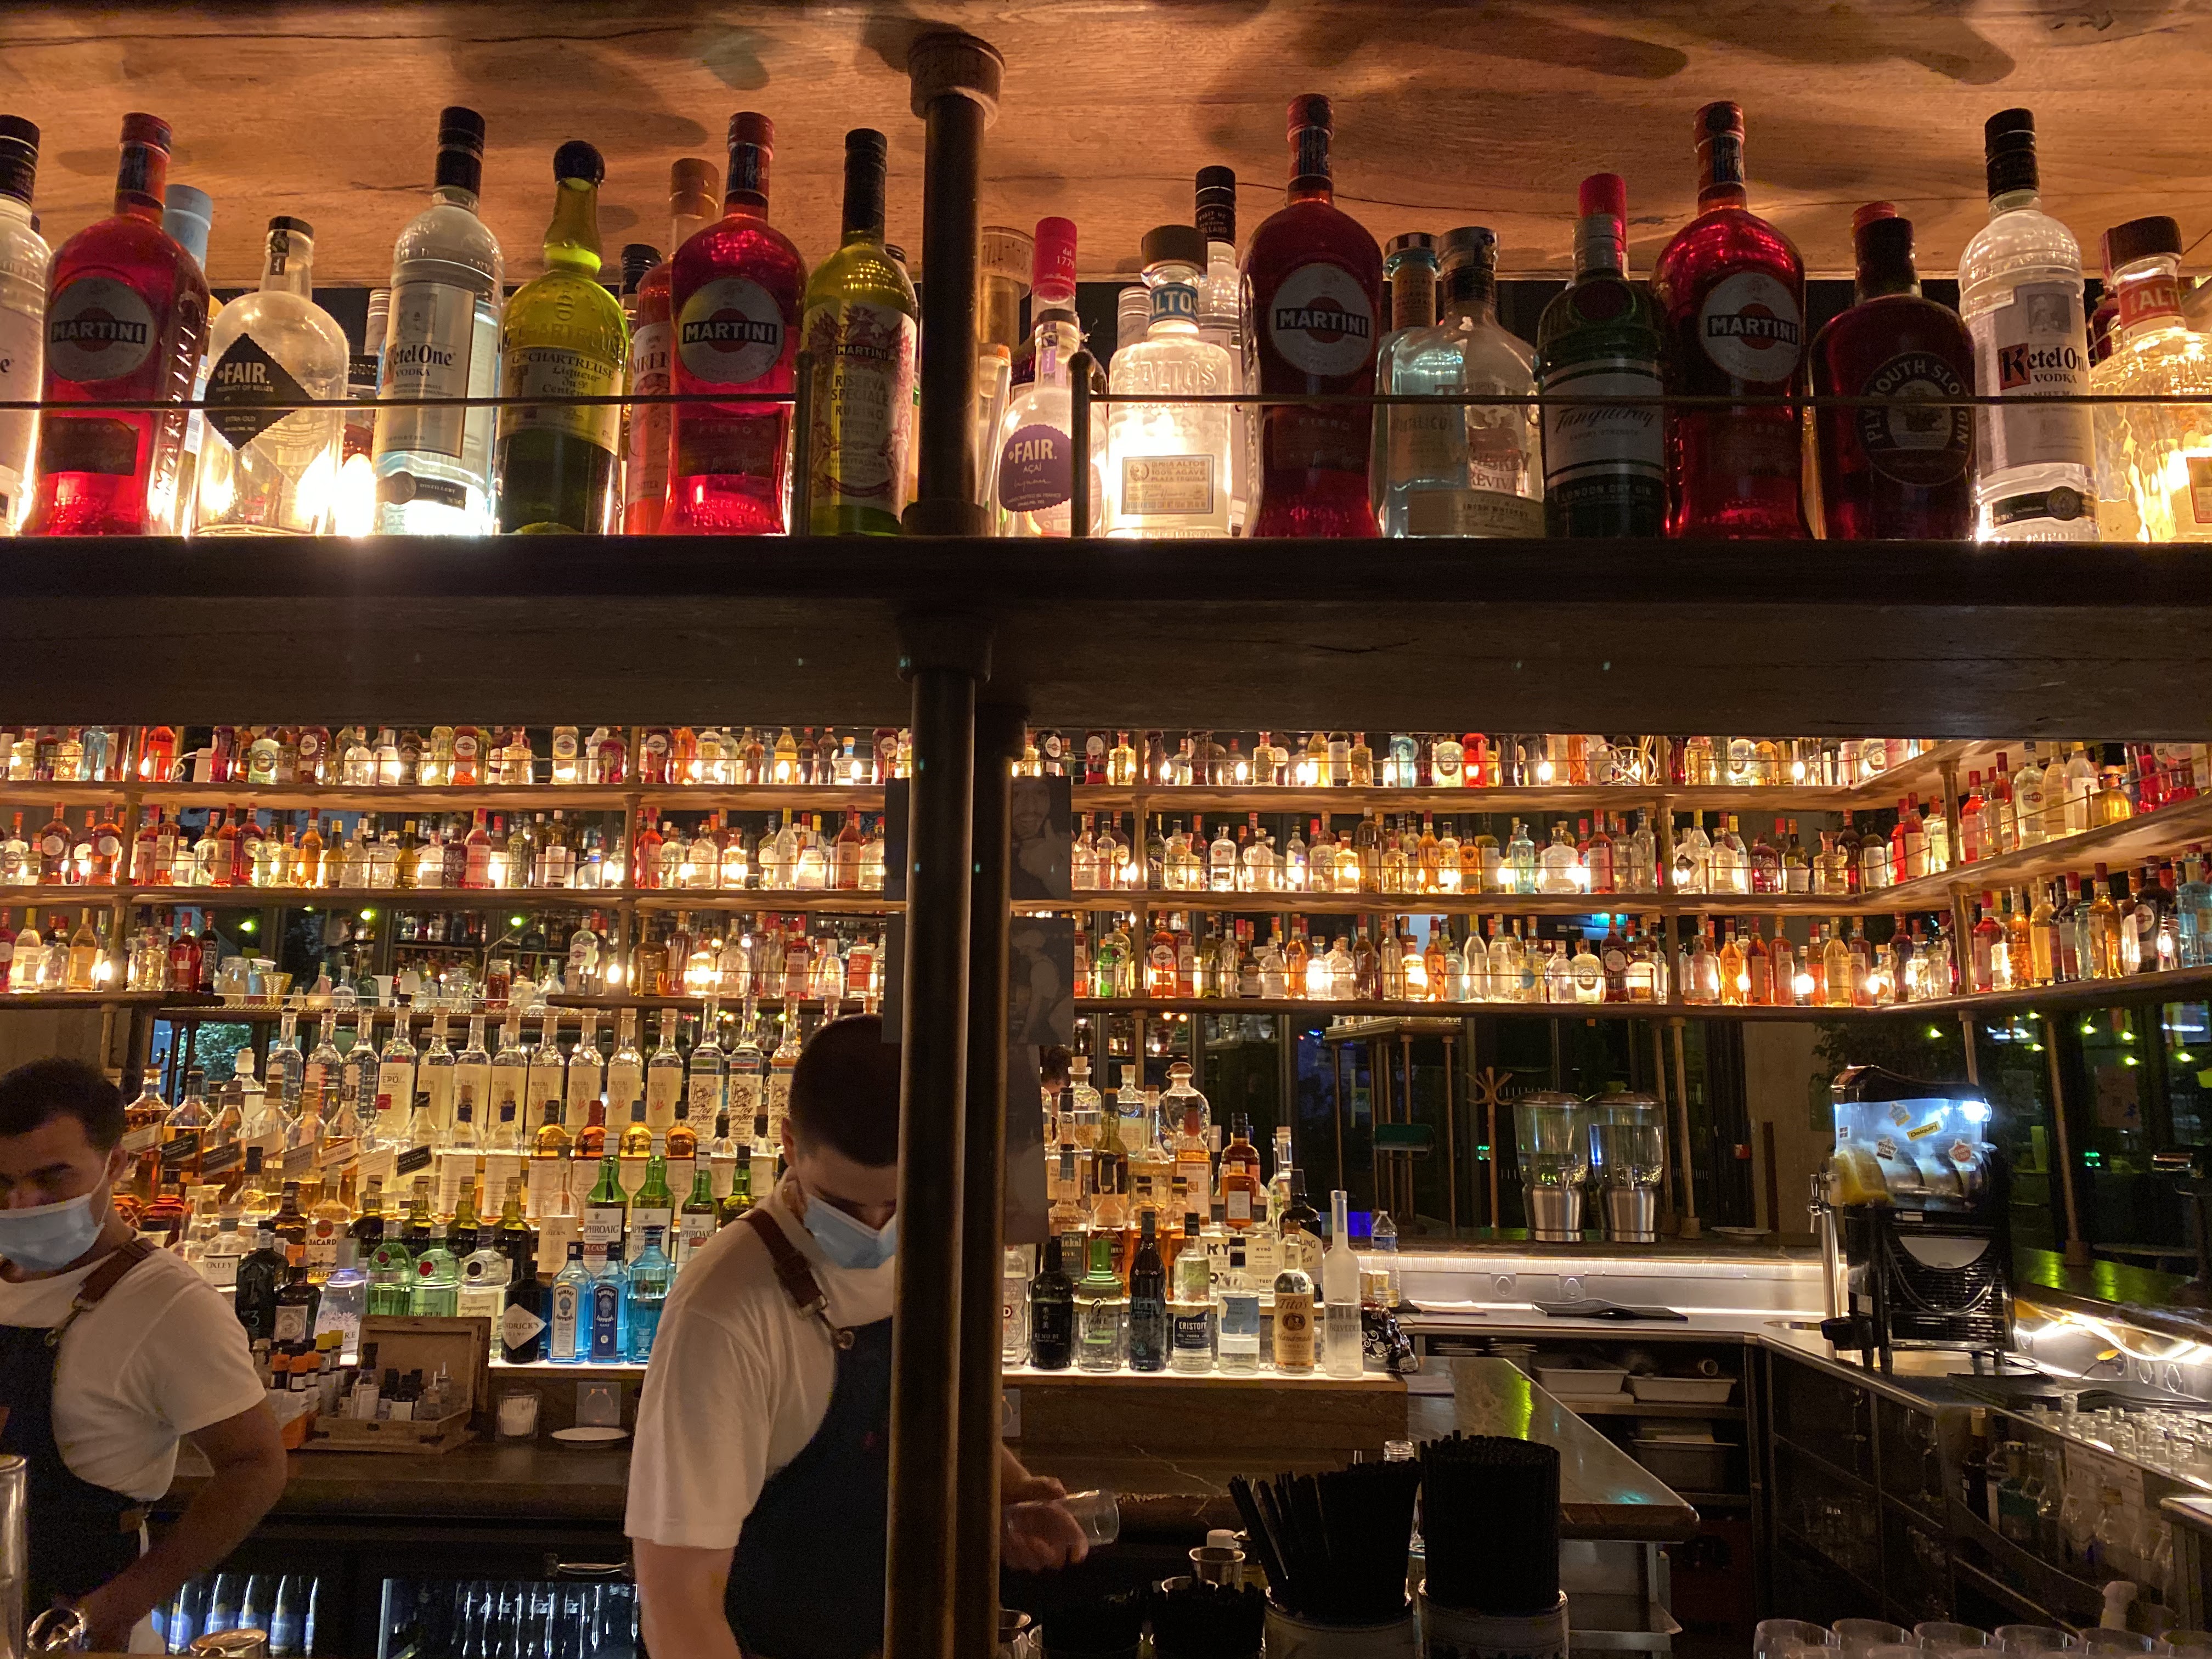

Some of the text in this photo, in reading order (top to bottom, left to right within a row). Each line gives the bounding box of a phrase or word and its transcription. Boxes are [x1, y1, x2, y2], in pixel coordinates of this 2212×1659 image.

[1063, 246, 1072, 257] dal
[1056, 256, 1075, 269] 1779
[2138, 286, 2177, 308] ALT
[1279, 310, 1368, 337] MARTINI
[1712, 317, 1797, 342] MARTINI
[53, 321, 146, 344] MARTINI
[684, 323, 775, 345] MARTINI
[419, 345, 453, 366] One
[529, 352, 614, 380] CHARTREUSE
[2001, 346, 2086, 383] Ketel On
[2034, 373, 2078, 384] VODKA
[1910, 1124, 1938, 1138] Daiquiri
[584, 1224, 620, 1234] APHROAIG
[460, 1303, 491, 1311] Tanqueray
[1279, 1298, 1308, 1310] Tito's
[504, 1321, 539, 1330] NDRICK'S
